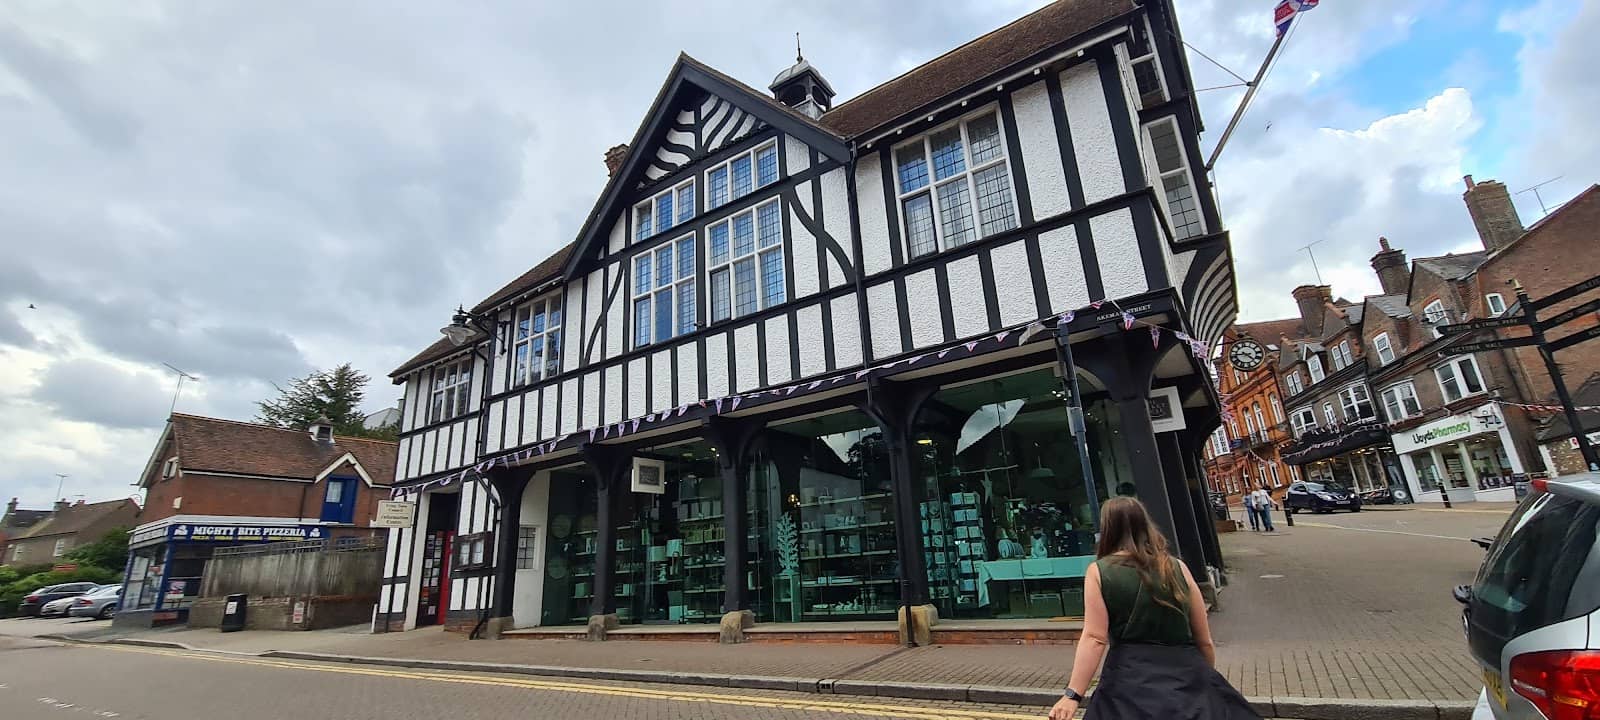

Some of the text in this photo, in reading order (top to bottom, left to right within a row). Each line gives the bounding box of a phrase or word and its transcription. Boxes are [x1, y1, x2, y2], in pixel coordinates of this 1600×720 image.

[1126, 304, 1151, 313] STREET
[1412, 421, 1471, 444] LloydsPharmacy
[193, 526, 306, 537] MIGHTY BITE PIZZERIA
